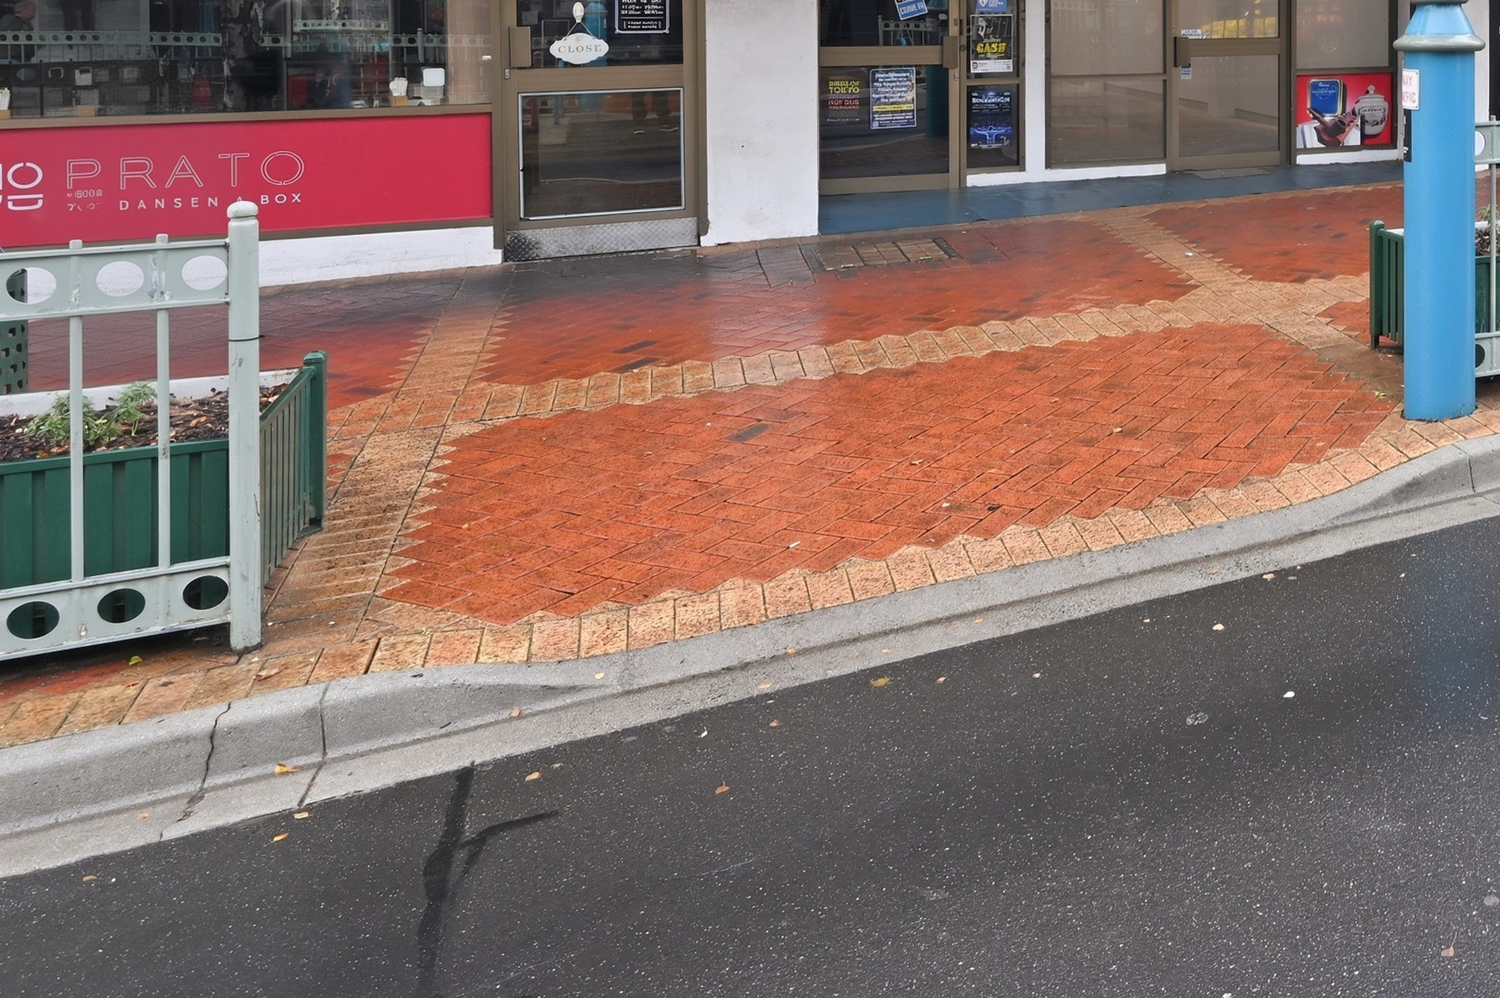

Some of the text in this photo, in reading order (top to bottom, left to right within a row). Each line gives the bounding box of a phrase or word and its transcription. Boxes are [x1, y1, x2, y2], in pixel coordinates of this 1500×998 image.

[558, 44, 602, 53] CLOSE
[976, 43, 1007, 54] CASH
[66, 150, 305, 190] PRATO
[119, 197, 219, 211] DANSEN
[260, 193, 302, 205] BOX
